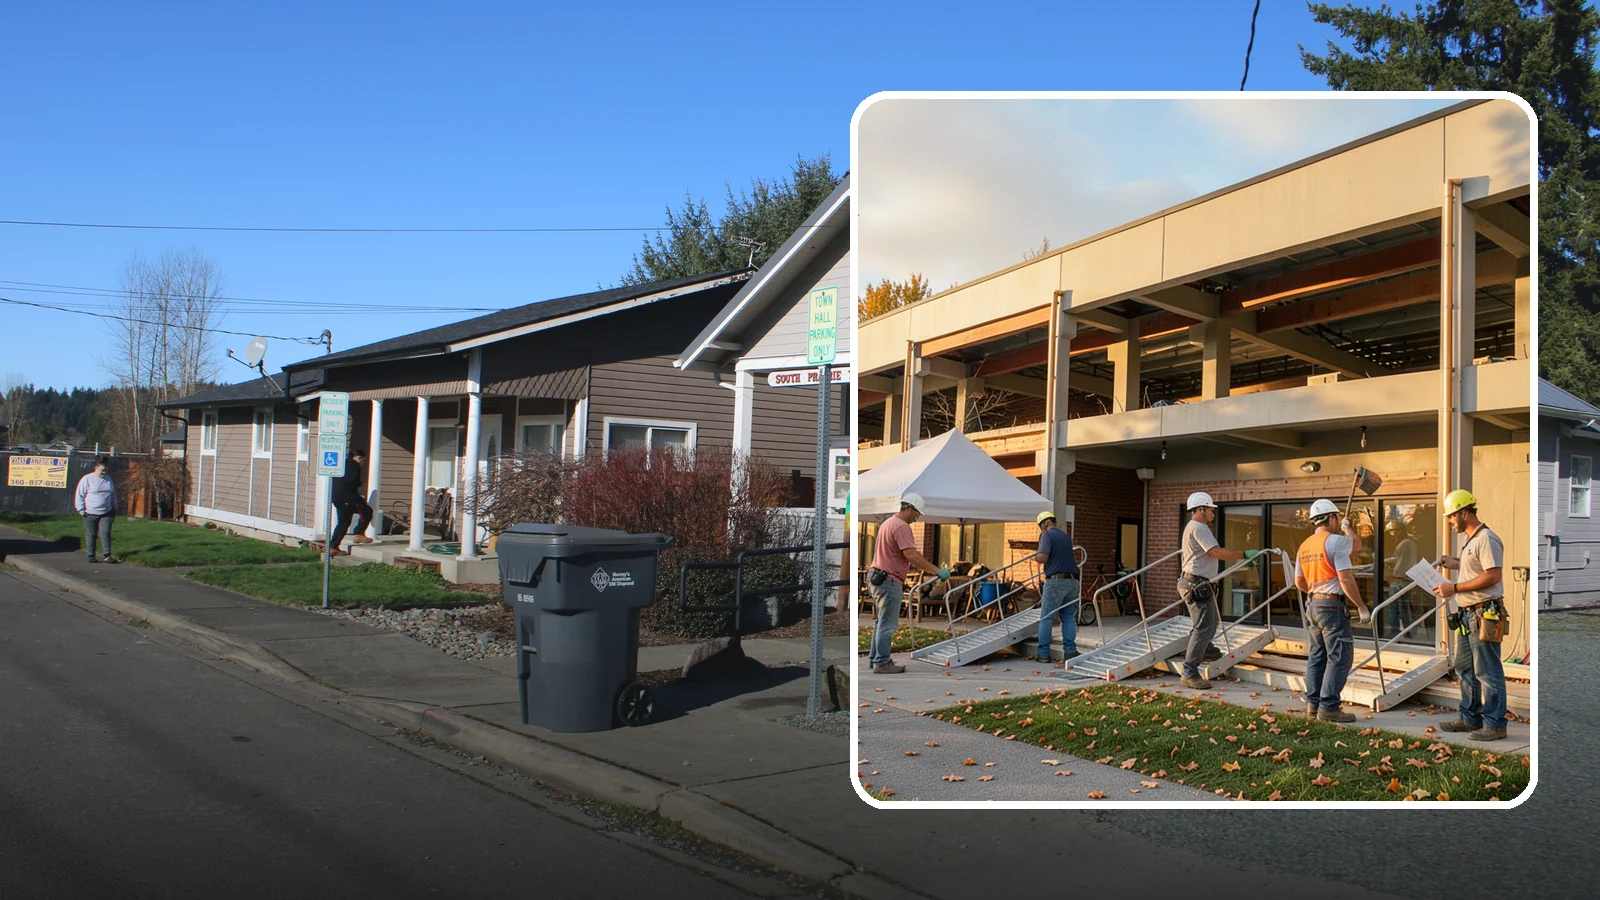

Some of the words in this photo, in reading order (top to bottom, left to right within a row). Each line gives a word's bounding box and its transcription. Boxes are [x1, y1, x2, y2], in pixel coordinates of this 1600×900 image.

[815, 294, 833, 308] TOWN
[814, 312, 831, 324] HALL
[810, 326, 836, 341] PARKING
[813, 344, 831, 357] ONLY
[775, 373, 801, 384] SOUTH
[807, 371, 841, 382] PRIE
[325, 420, 341, 428] ONLY
